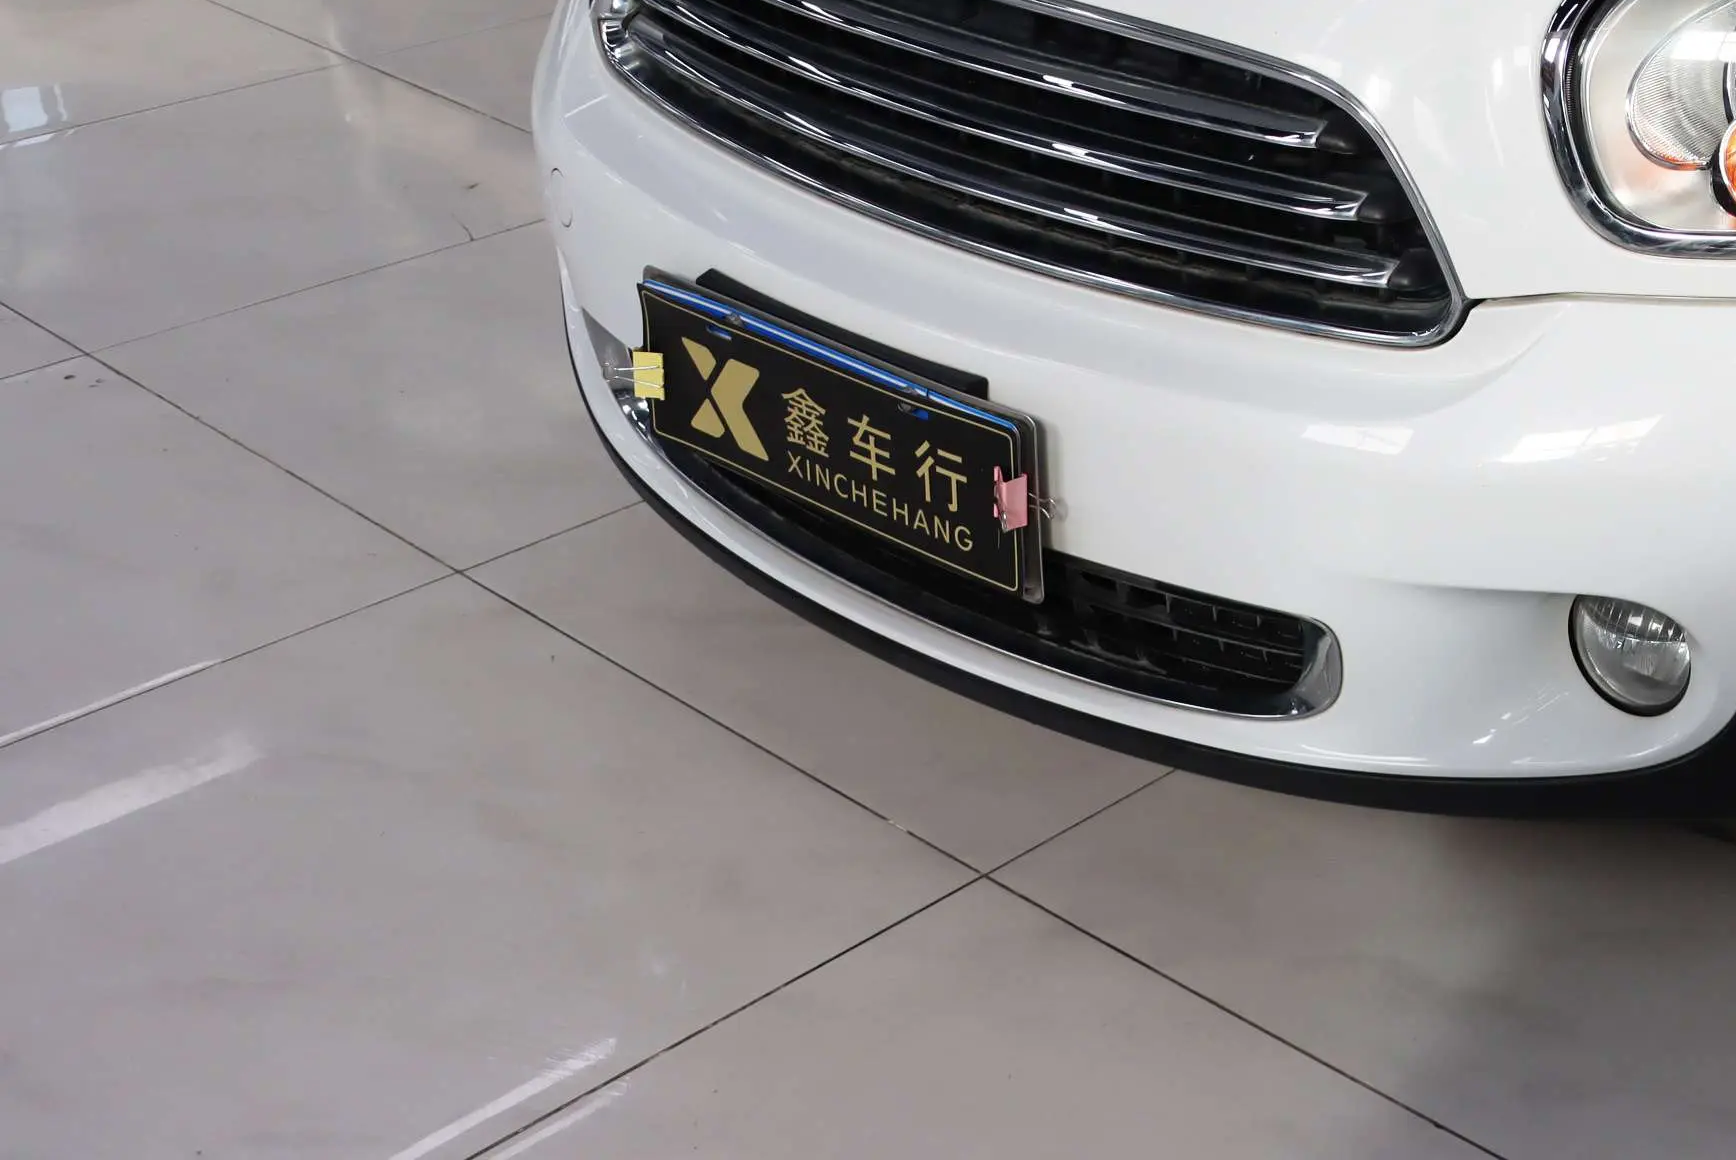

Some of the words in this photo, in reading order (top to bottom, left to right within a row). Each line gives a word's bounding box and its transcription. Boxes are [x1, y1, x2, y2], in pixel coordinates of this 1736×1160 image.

[781, 387, 968, 513] 鑫车行
[786, 449, 974, 552] XINCHEHANG
